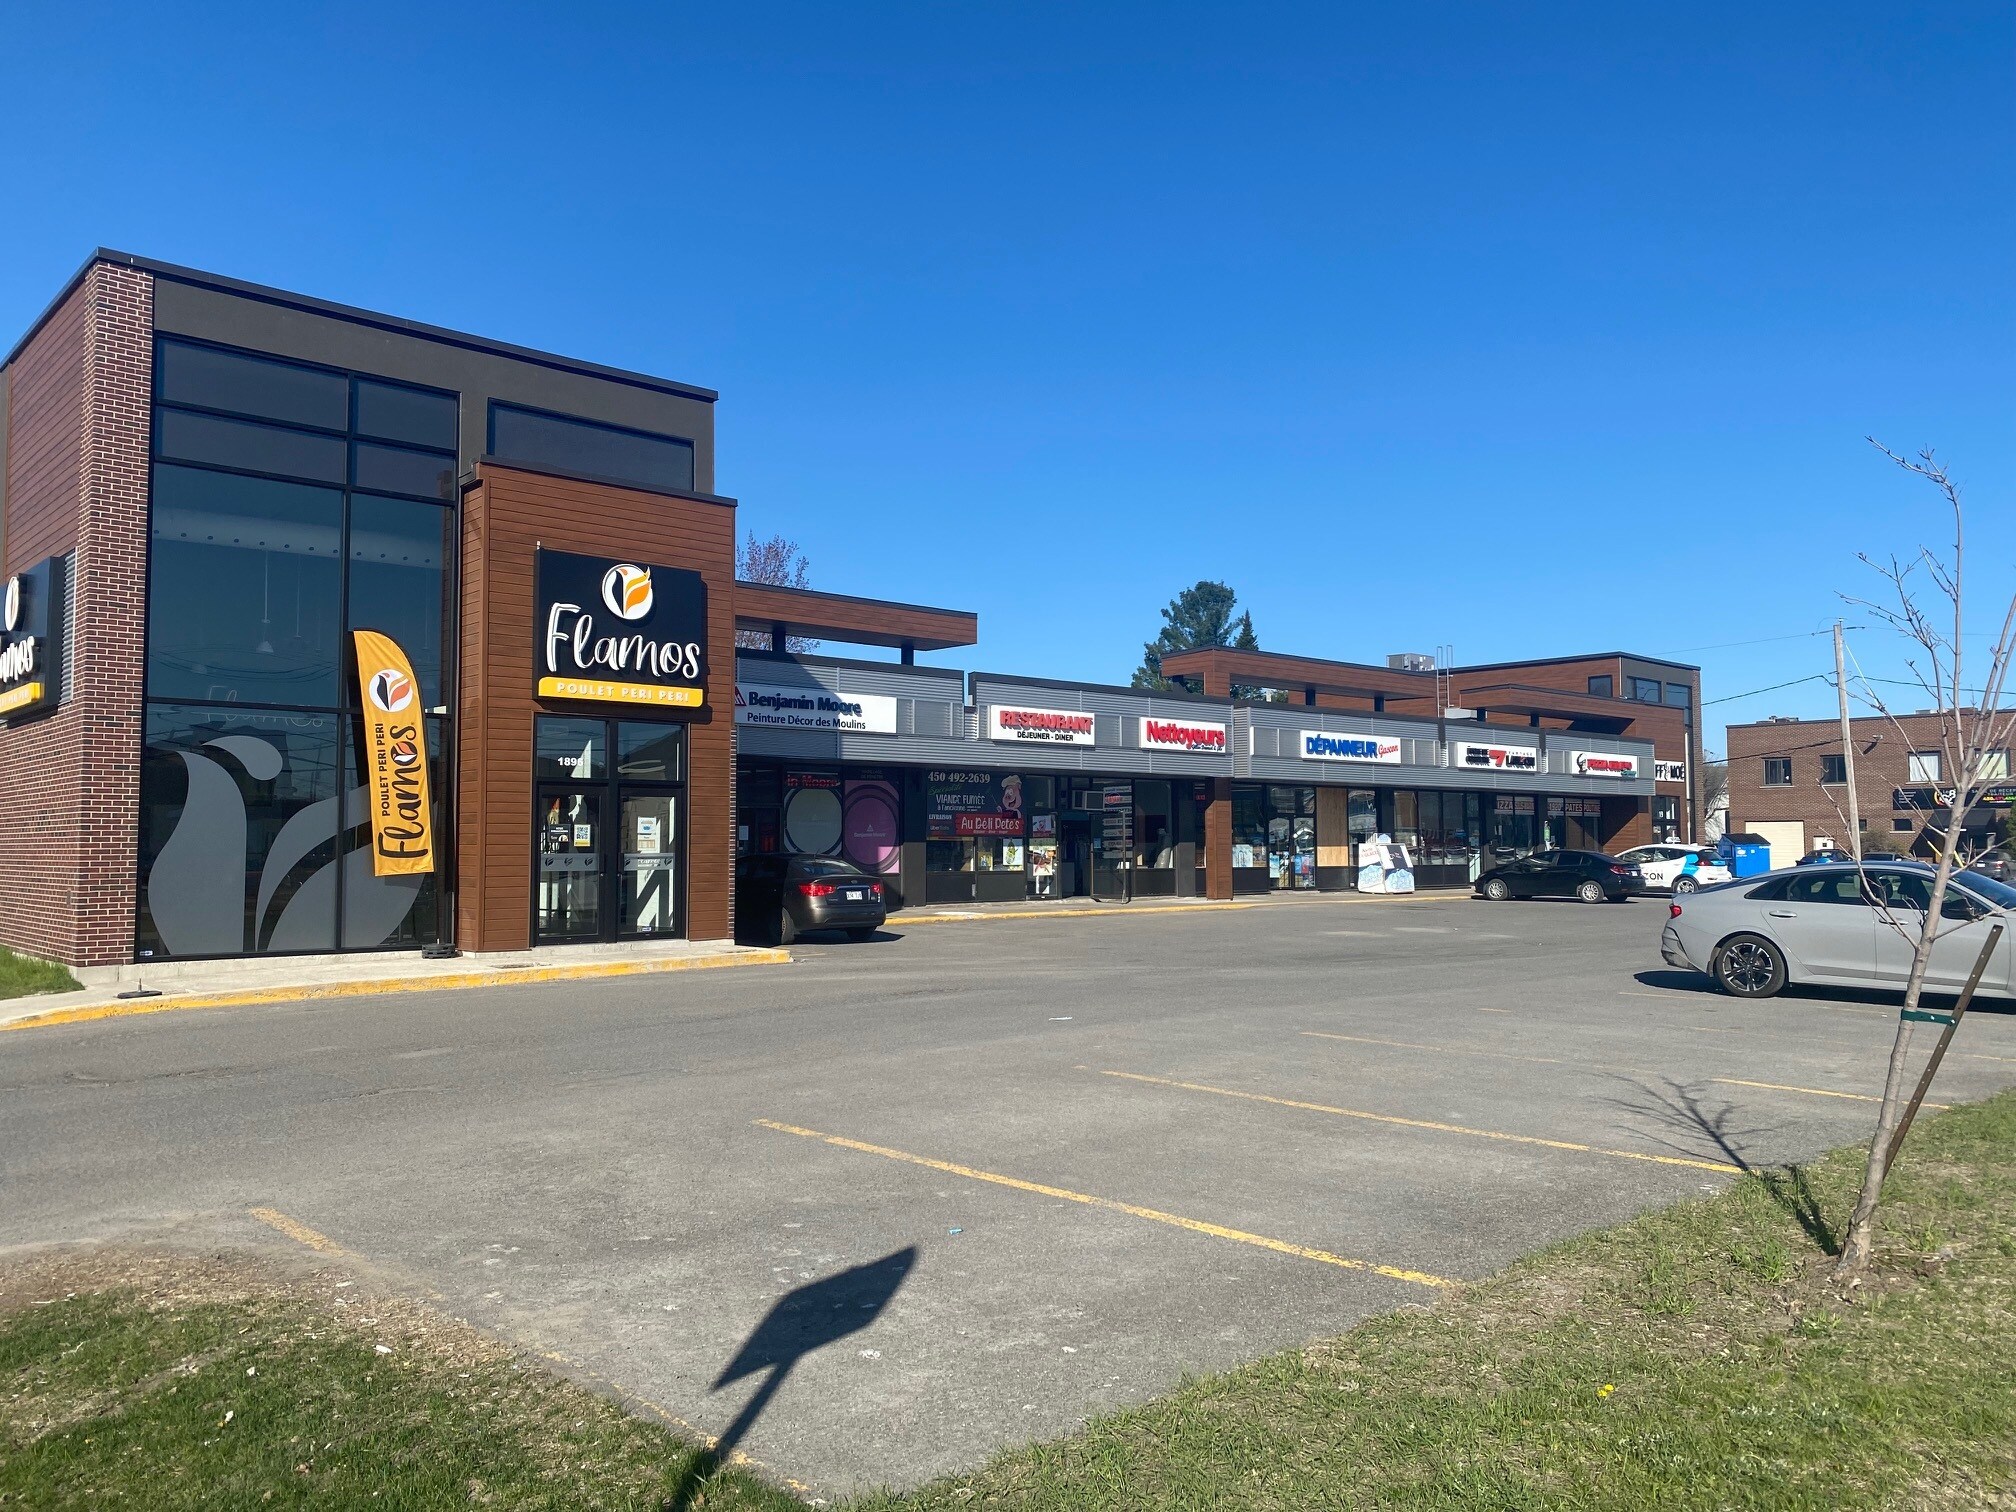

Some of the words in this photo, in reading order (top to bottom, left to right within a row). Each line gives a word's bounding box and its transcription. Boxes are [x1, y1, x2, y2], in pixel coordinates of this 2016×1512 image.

[546, 602, 700, 679] Flamos
[0, 636, 35, 682] amos
[557, 682, 614, 697] POULET
[621, 686, 652, 699] PERI
[659, 688, 689, 702] PERI
[748, 691, 815, 711] Benjamin
[818, 697, 862, 716] Moore
[747, 713, 786, 724] Peinture
[787, 715, 814, 725] Décor
[815, 717, 831, 727] des
[832, 718, 866, 730] Moulins
[1000, 711, 1093, 734] RESTAURANT
[375, 723, 384, 746] PERI
[1146, 721, 1226, 749] Nettoyeurs
[1306, 734, 1378, 758] DÉPANNEUR
[378, 749, 388, 772] PERI
[928, 771, 945, 782] 450
[948, 772, 991, 784] 492-2639
[377, 725, 429, 858] Flamos
[380, 776, 391, 817] POULET
[961, 817, 973, 829] Au
